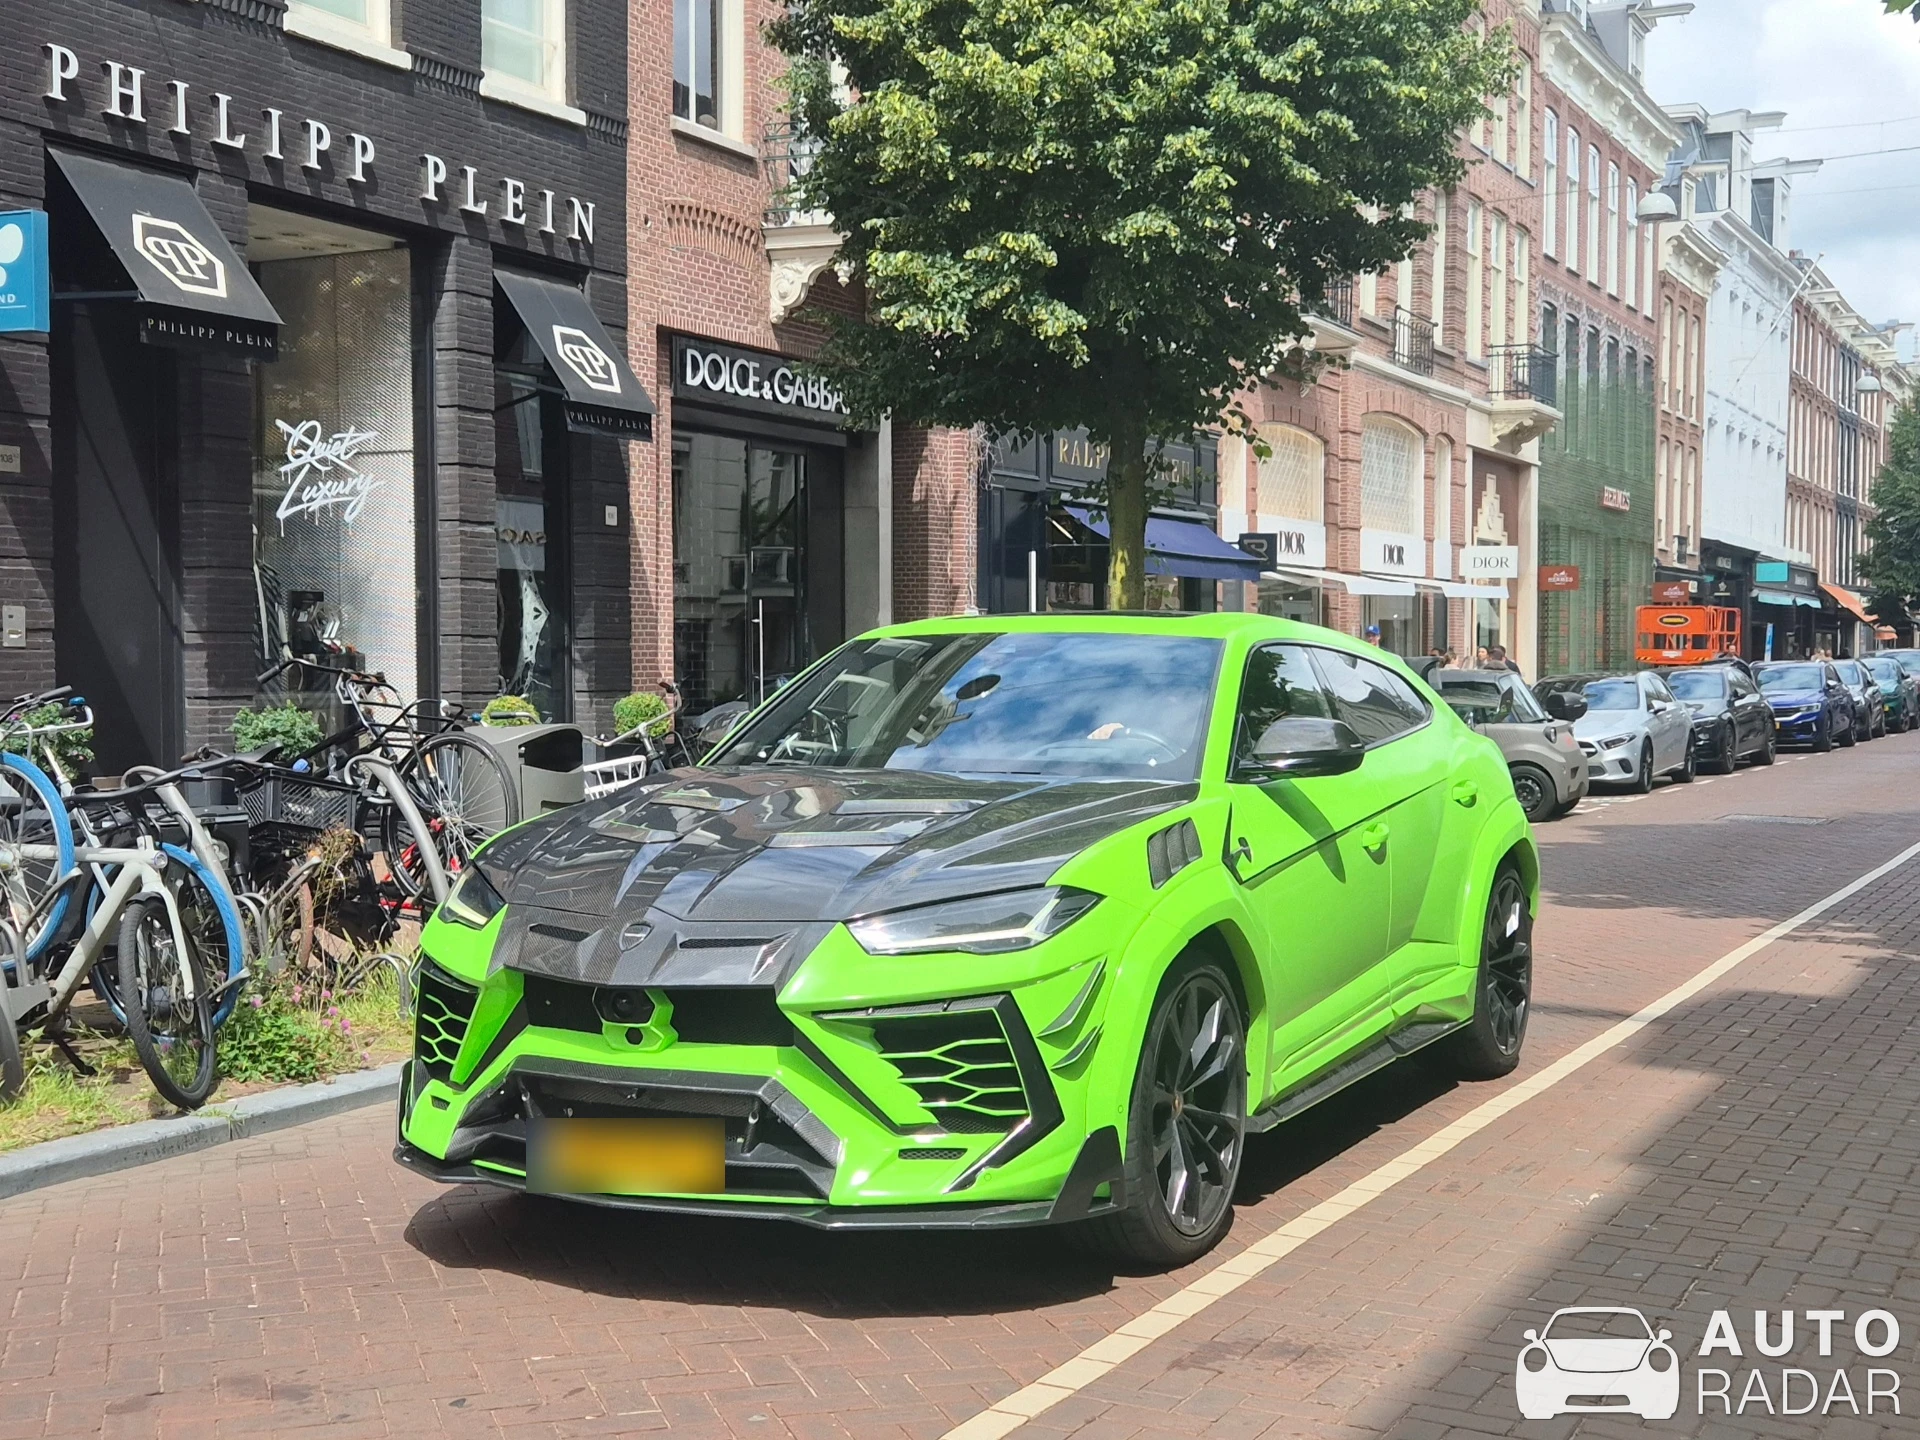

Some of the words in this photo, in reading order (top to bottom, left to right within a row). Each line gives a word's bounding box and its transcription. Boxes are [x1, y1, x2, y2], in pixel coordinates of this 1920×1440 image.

[46, 43, 376, 183] PHILIPP
[419, 153, 596, 244] PLEIN
[147, 317, 215, 339] PHILIPP
[226, 330, 273, 348] PLEIN
[569, 411, 613, 426] PHILIPP
[619, 419, 650, 431] PLEIN
[275, 418, 380, 475] Quiet
[276, 463, 387, 525] Luxury
[1279, 530, 1305, 555] DIOR
[1383, 543, 1405, 566] DIOR
[1472, 556, 1510, 569] DIOR
